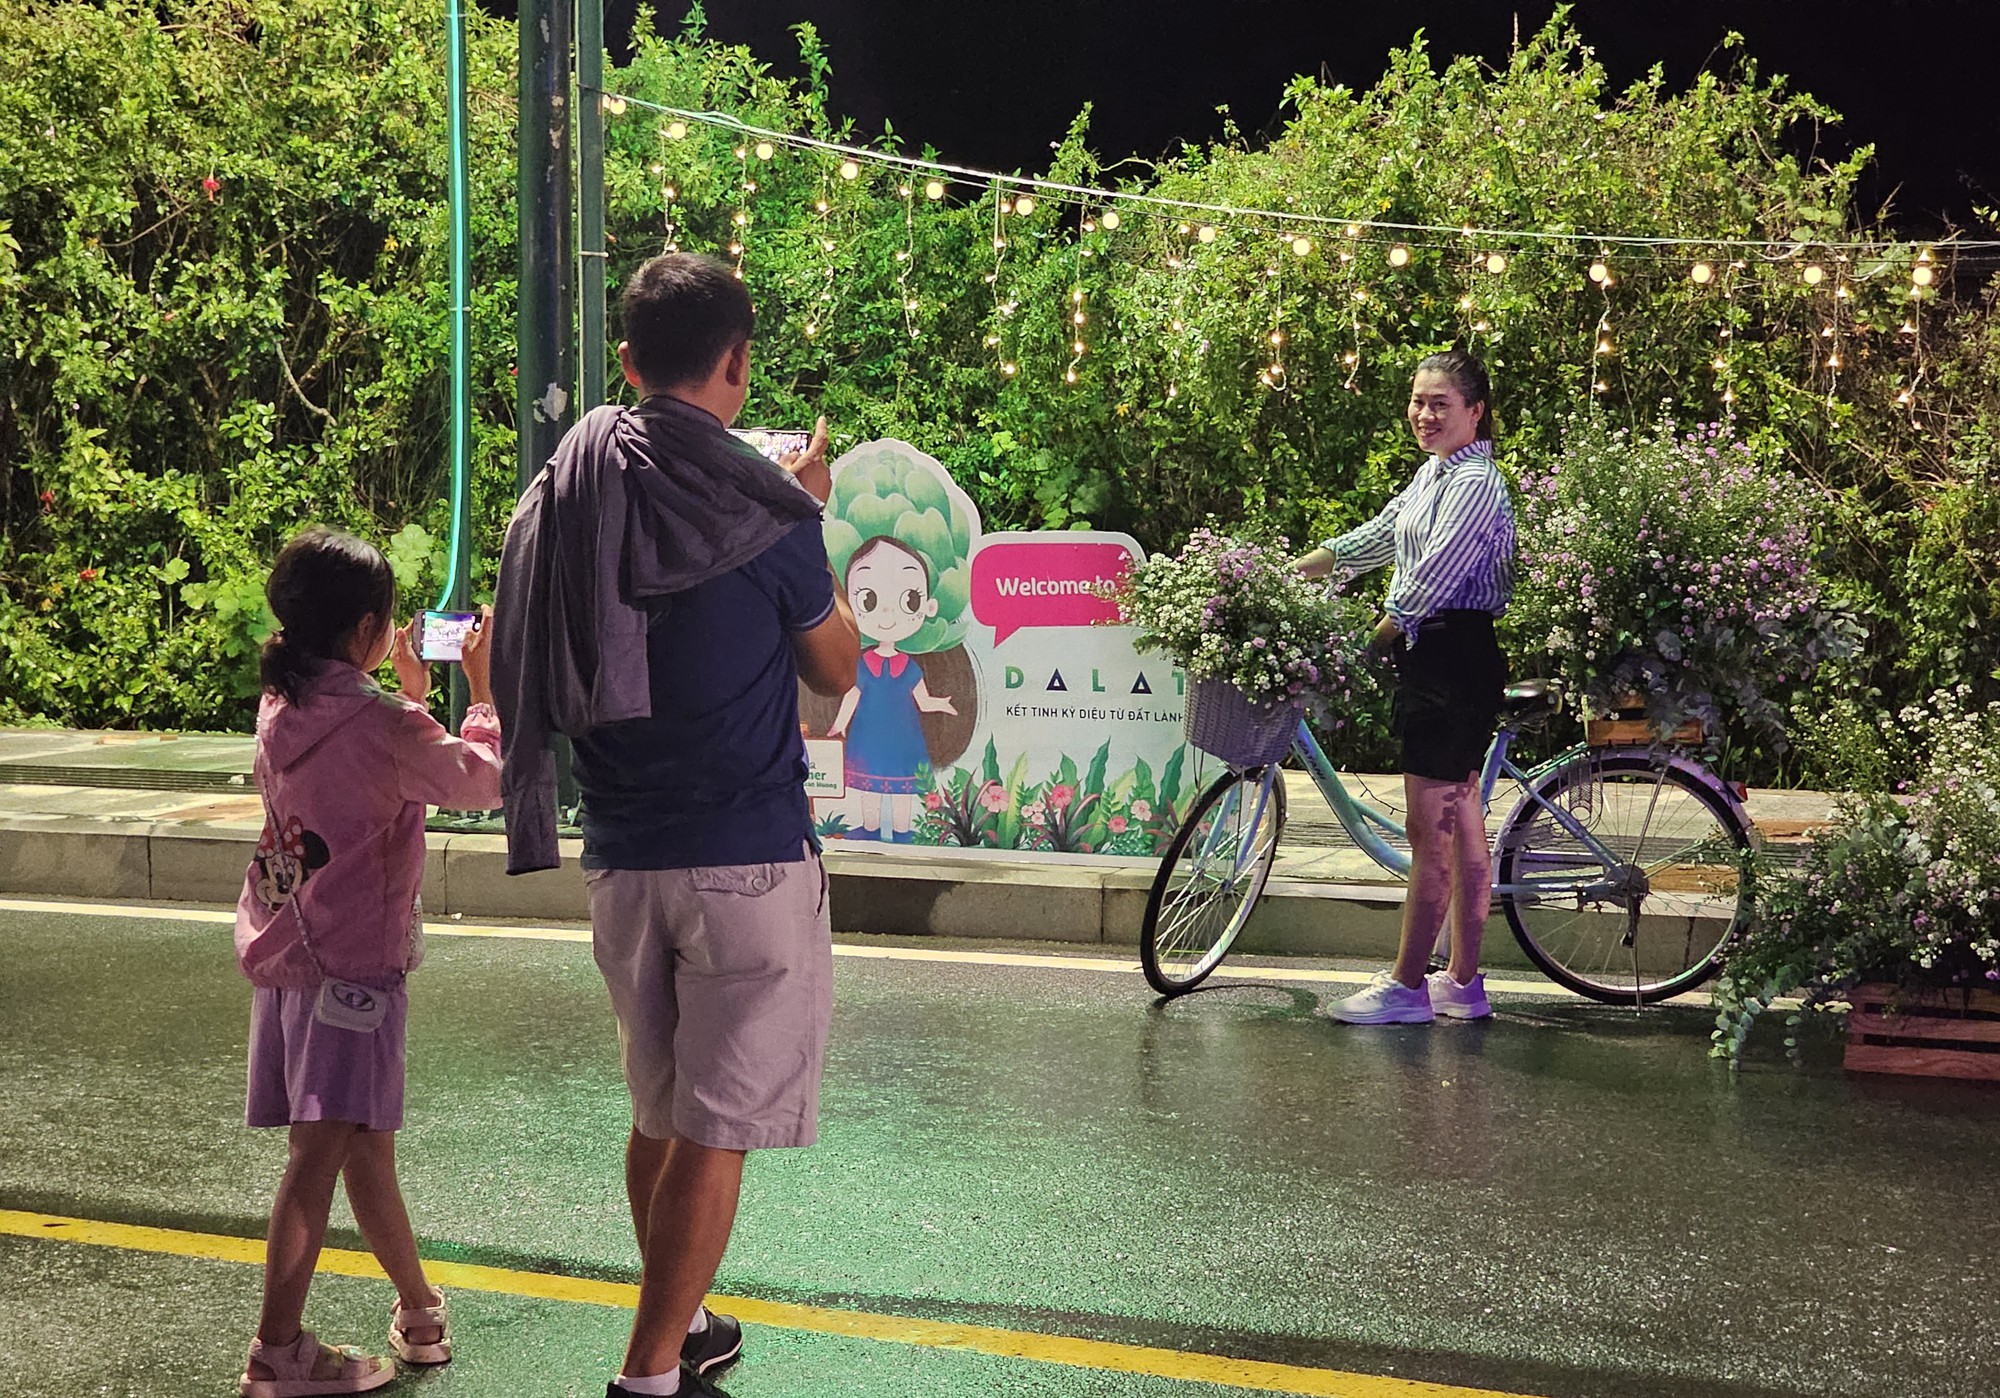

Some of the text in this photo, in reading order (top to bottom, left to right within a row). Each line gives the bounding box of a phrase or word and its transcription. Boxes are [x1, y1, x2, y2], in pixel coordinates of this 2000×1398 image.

[995, 575, 1115, 597] Welcome to
[1006, 703, 1027, 716] KẾT
[1031, 706, 1058, 717] TINH
[1079, 707, 1106, 721] DIỆU
[1109, 708, 1125, 720] TỪ
[1128, 707, 1150, 721] ĐẤT
